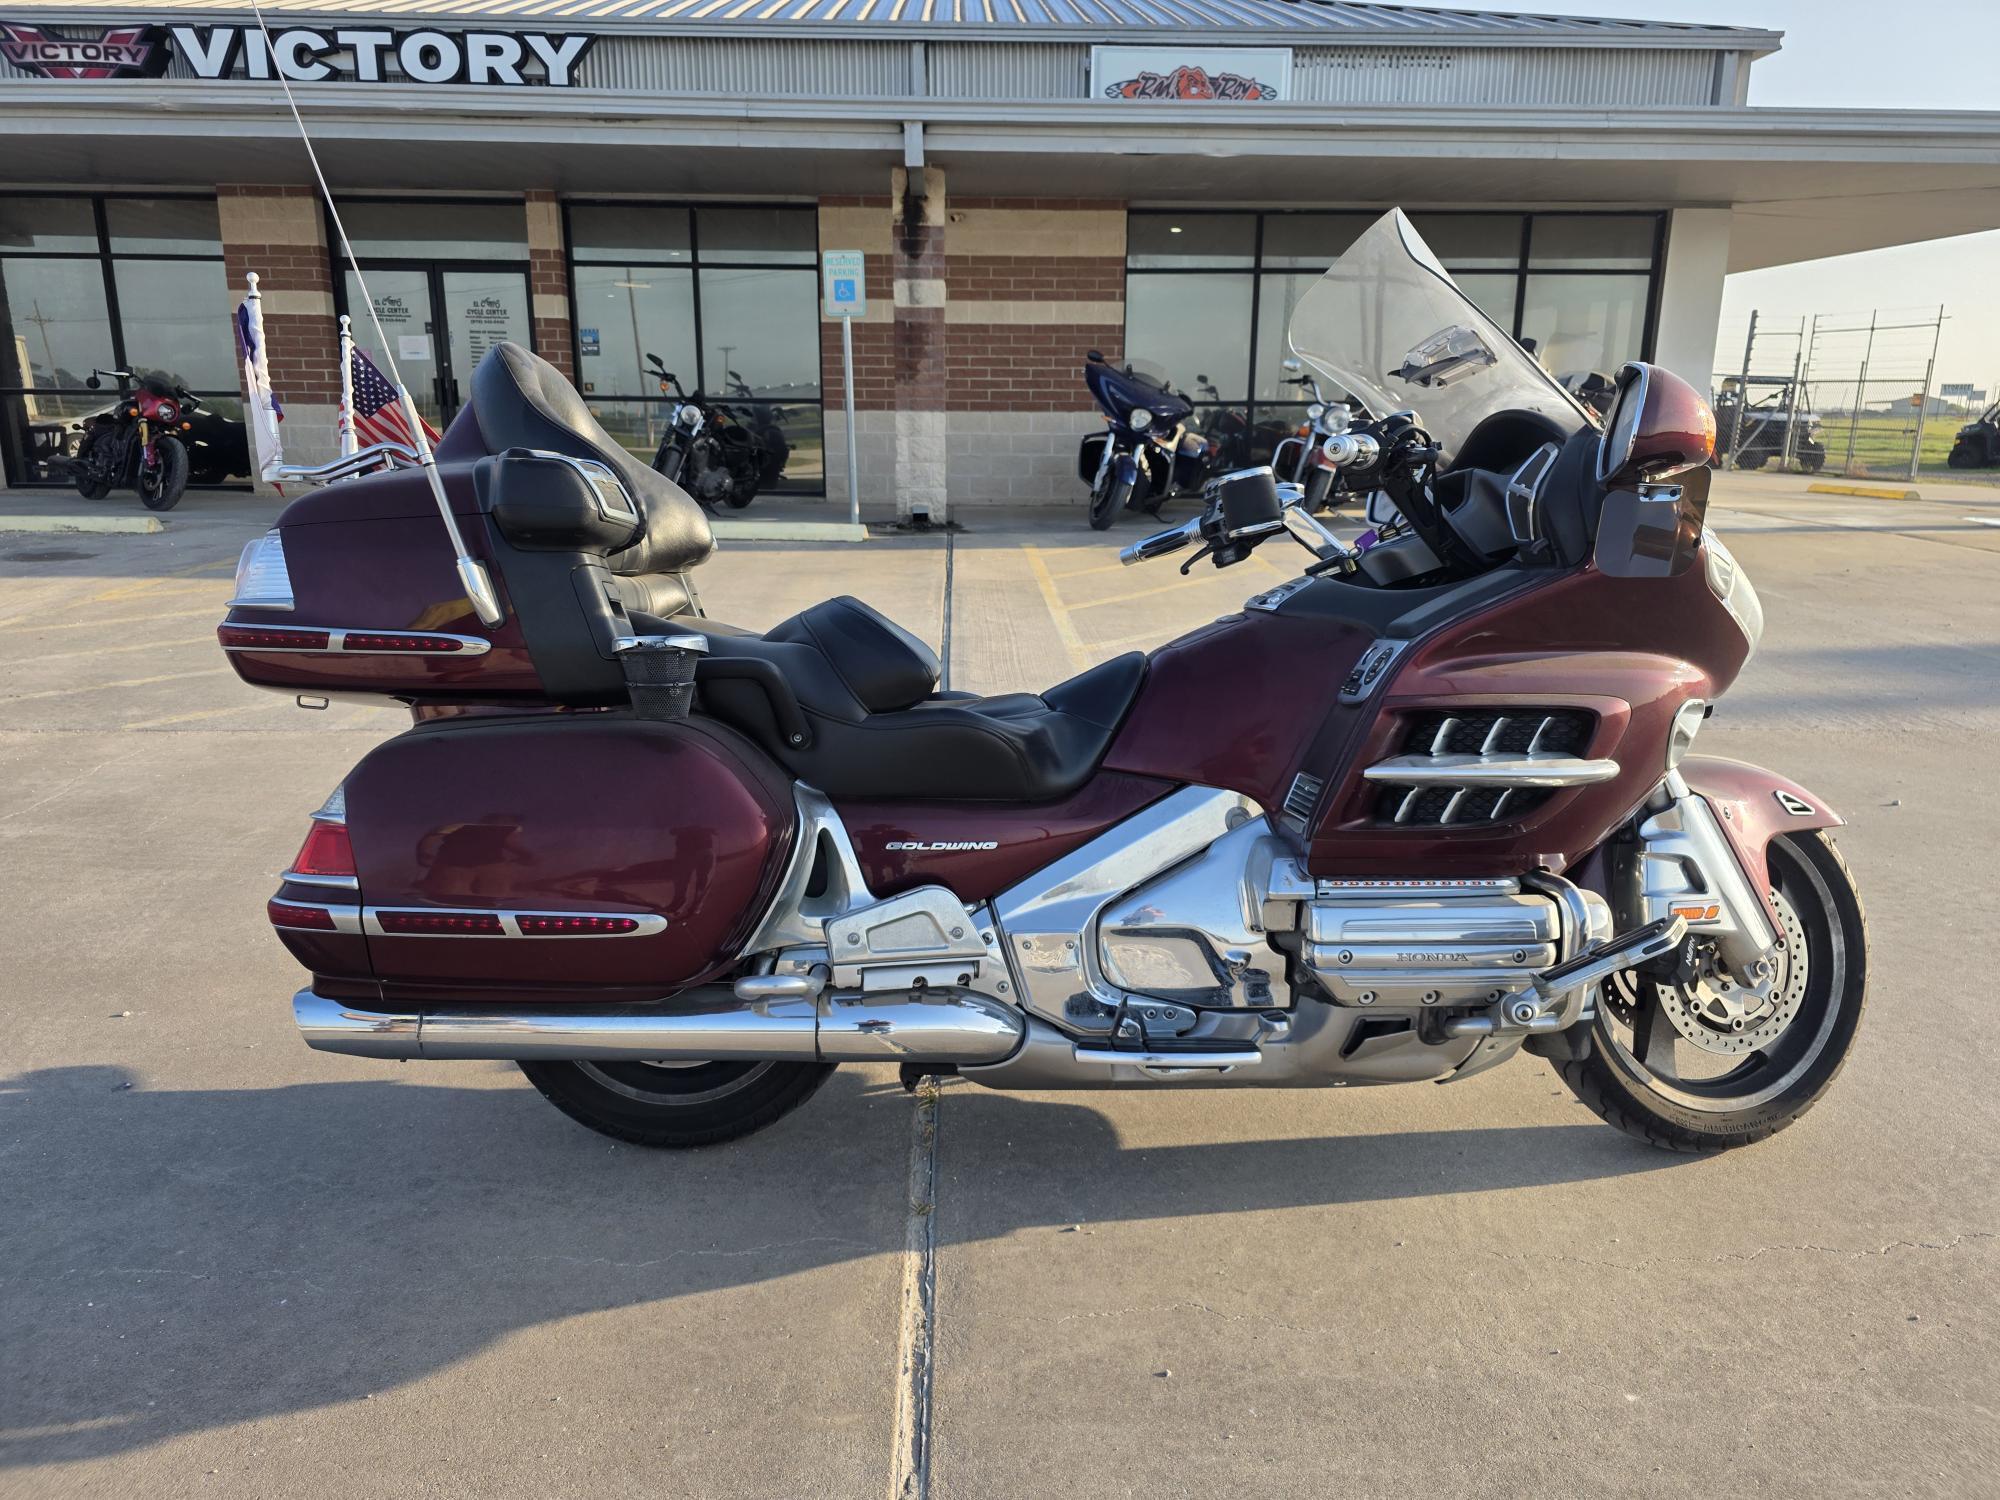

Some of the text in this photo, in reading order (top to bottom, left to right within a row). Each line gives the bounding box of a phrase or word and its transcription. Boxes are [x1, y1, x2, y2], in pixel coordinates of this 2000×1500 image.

[7, 43, 144, 63] VICTORY
[170, 24, 592, 86] VICTORY
[466, 308, 484, 316] CYCLE
[885, 841, 999, 850] GOLDWING
[1396, 952, 1470, 962] HONDA
